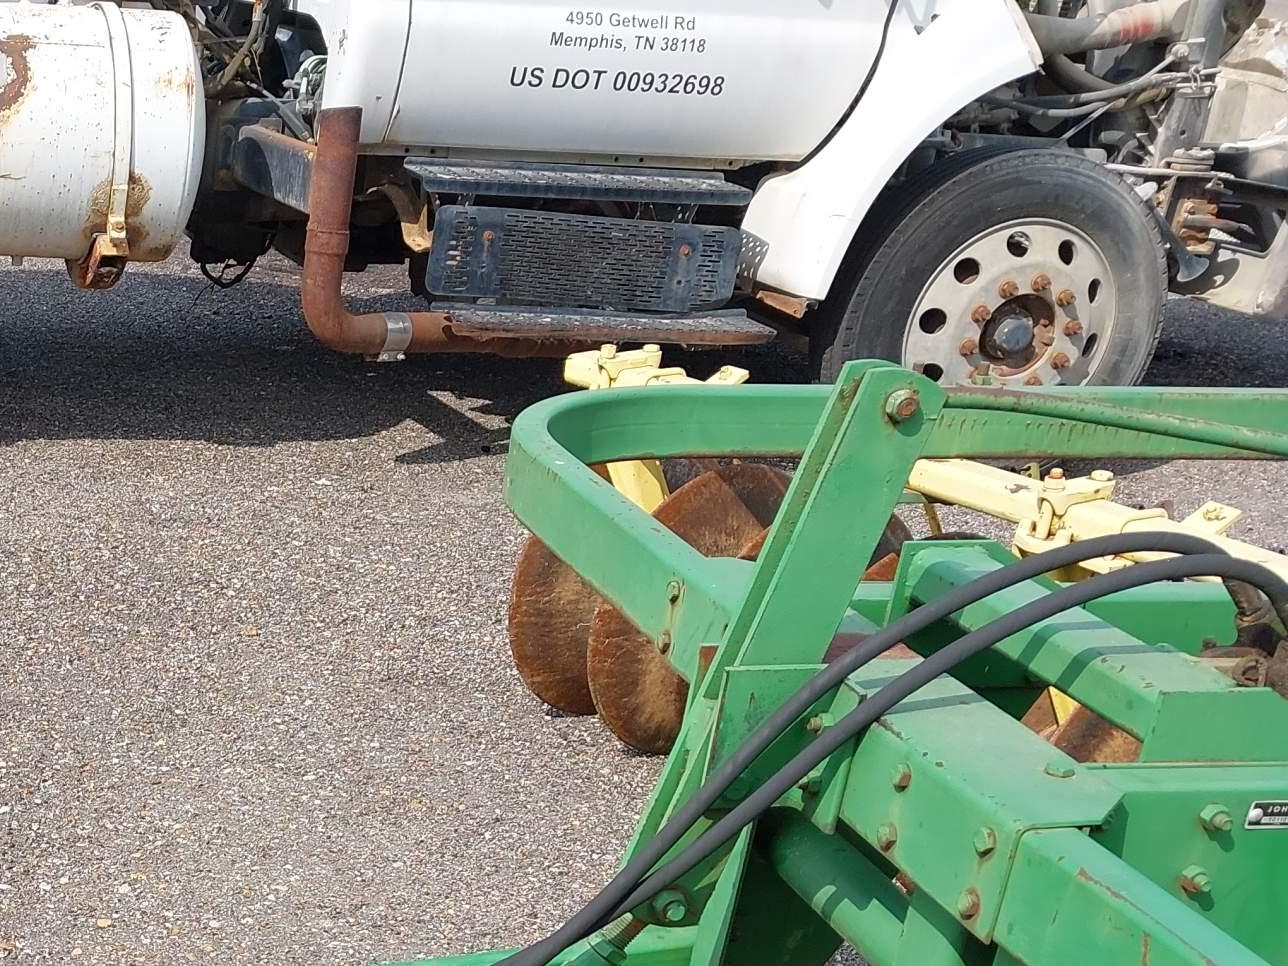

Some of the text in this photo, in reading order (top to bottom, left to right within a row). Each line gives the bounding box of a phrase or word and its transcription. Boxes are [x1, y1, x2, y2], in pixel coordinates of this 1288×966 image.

[565, 10, 696, 31] 4950 Getwell Rd
[549, 31, 707, 54] Memphis, TN 38118
[509, 66, 726, 97] US DOT 00932698
